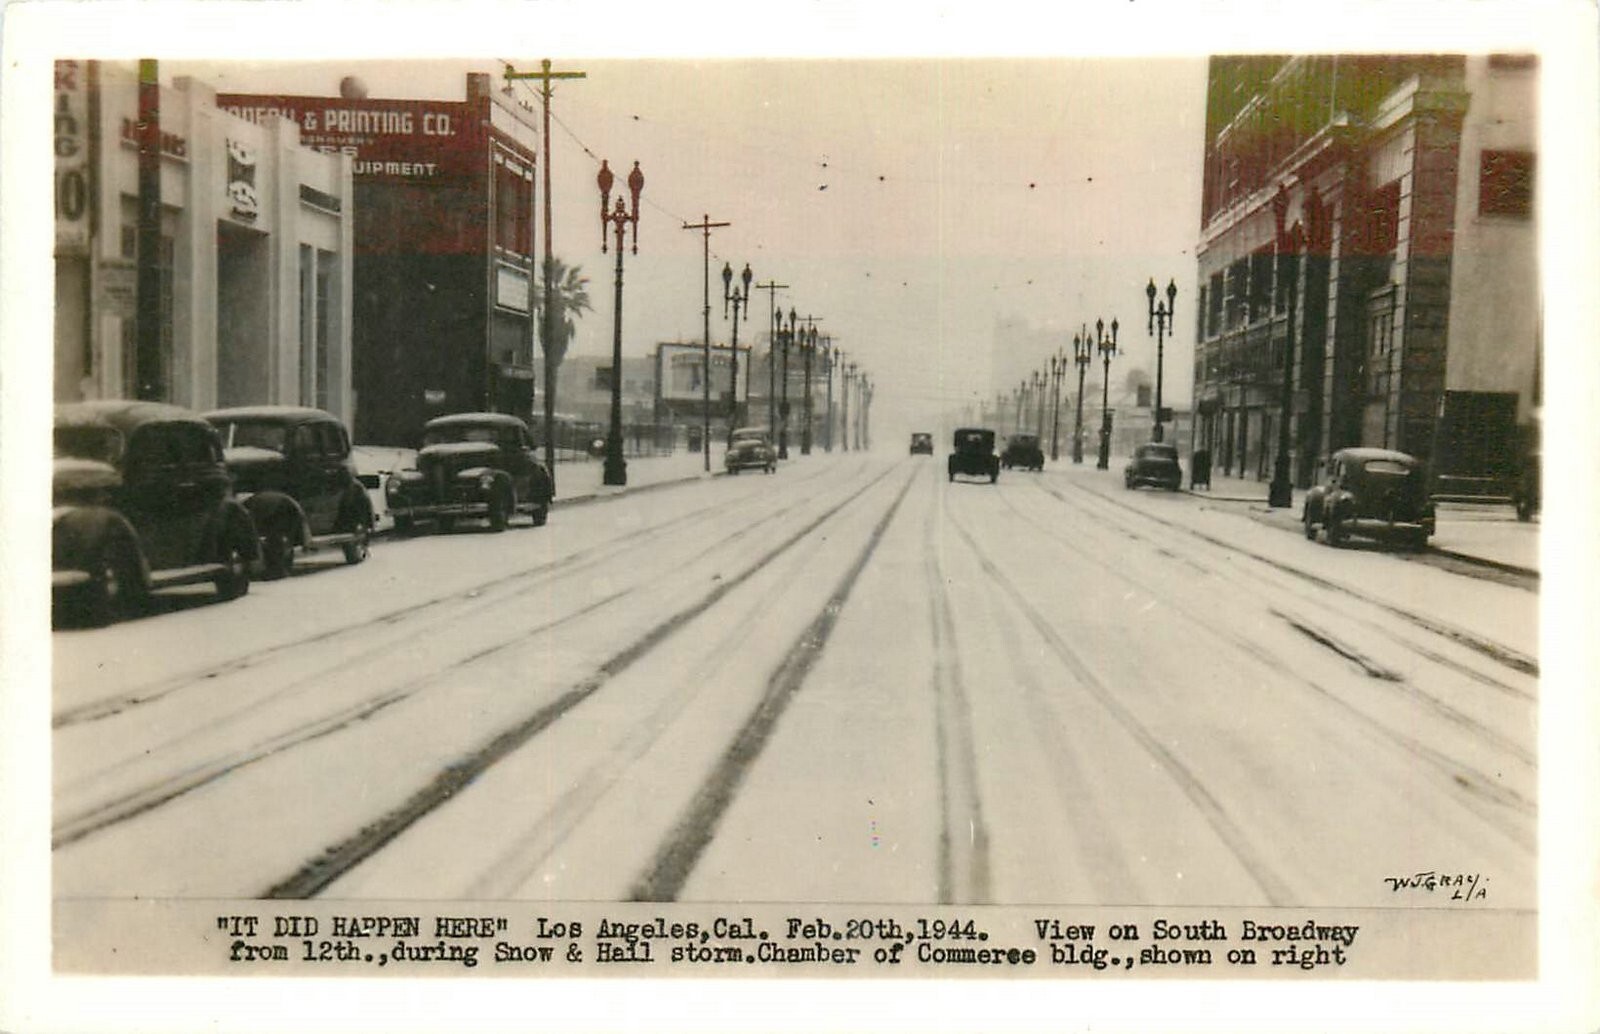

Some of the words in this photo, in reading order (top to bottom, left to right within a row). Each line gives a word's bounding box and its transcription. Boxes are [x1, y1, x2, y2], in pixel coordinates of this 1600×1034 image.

[305, 112, 318, 131] &
[325, 110, 413, 134] PRINTING
[423, 114, 456, 136] CO.
[352, 160, 437, 176] UIPMENT
